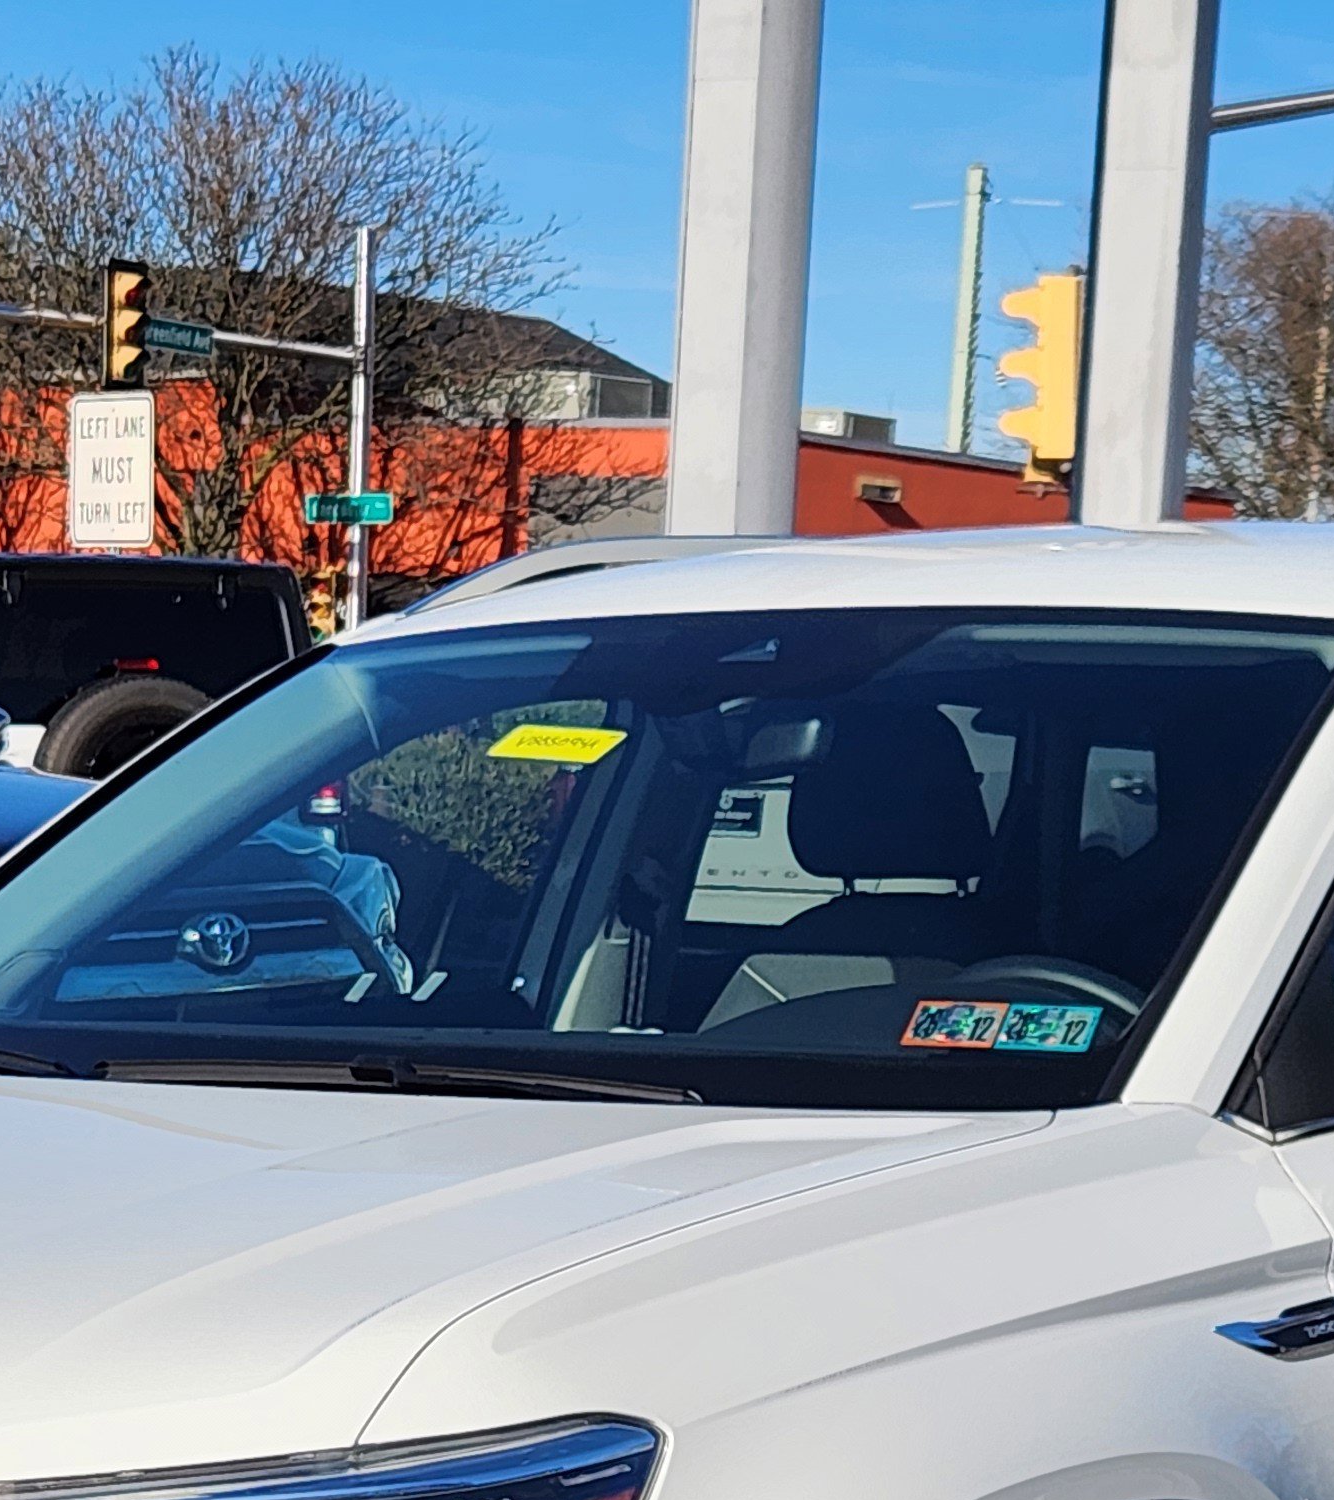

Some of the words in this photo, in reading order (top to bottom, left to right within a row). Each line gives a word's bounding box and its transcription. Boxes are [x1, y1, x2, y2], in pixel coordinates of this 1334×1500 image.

[80, 417, 109, 440] LEFT
[114, 415, 146, 439] LANE
[90, 456, 134, 484] MUST
[78, 502, 112, 525] TURN
[117, 501, 146, 525] LEFT
[967, 1015, 997, 1043] 12
[1059, 1019, 1089, 1047] 12
